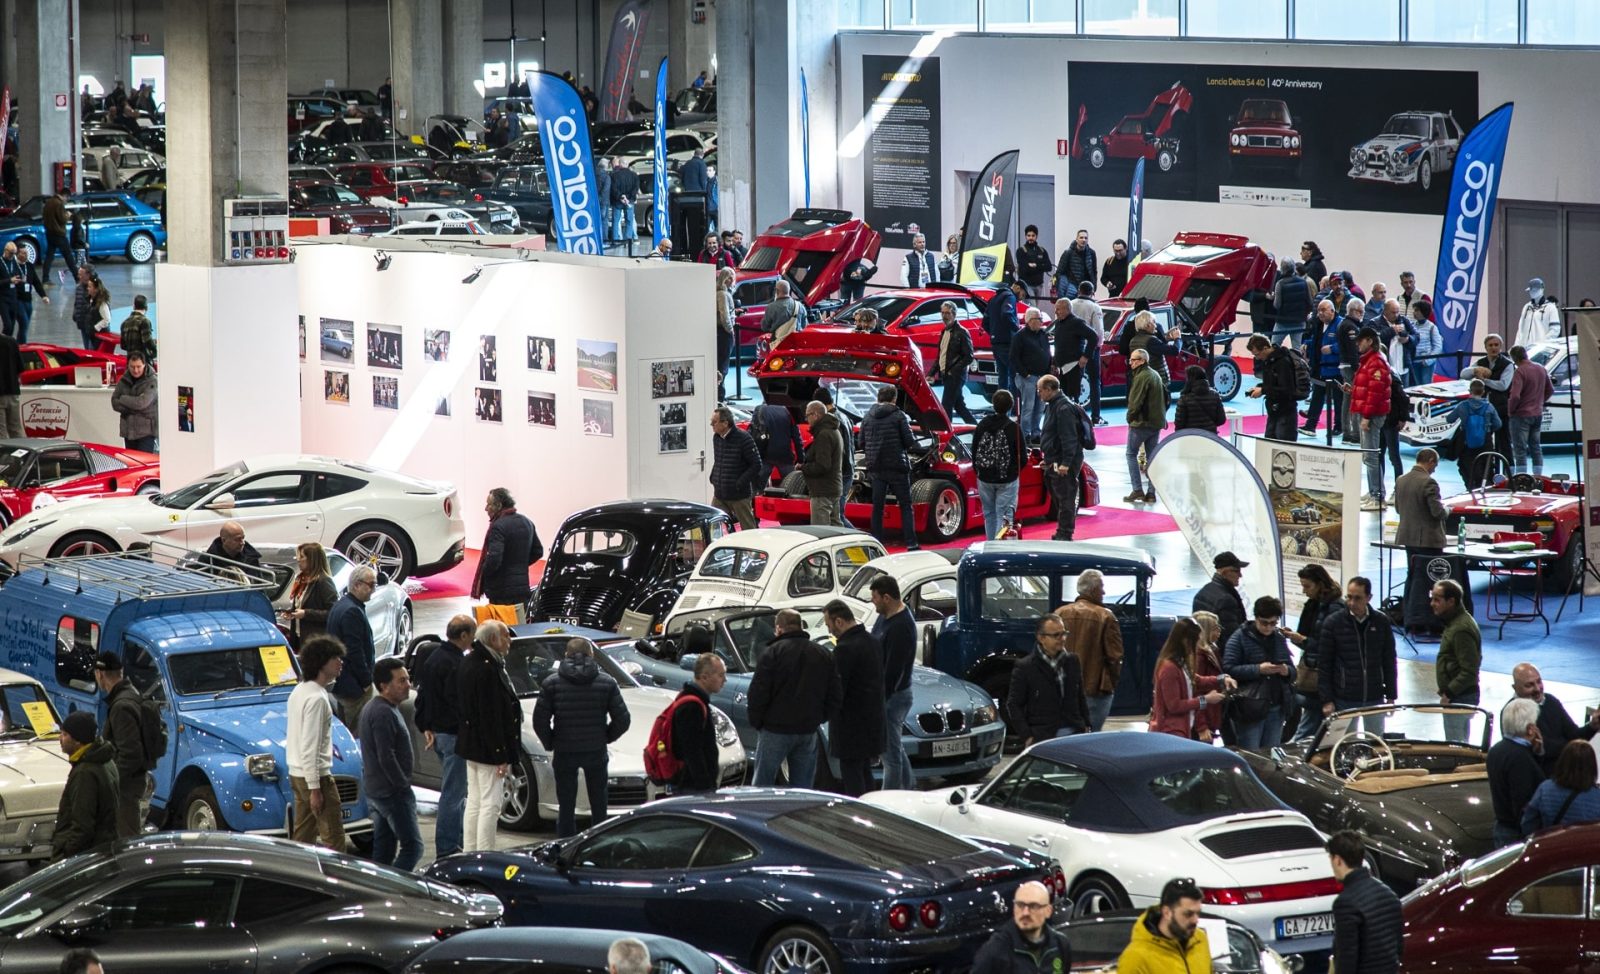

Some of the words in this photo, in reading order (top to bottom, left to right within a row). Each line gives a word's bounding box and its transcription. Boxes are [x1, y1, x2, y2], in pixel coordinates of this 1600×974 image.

[1206, 77, 1228, 86] Lancia
[1228, 77, 1246, 86] Delta
[1256, 78, 1266, 86] 40
[1284, 79, 1323, 90] Anniversary
[1442, 159, 1489, 330] sparco
[25, 413, 67, 426] Lamborghini
